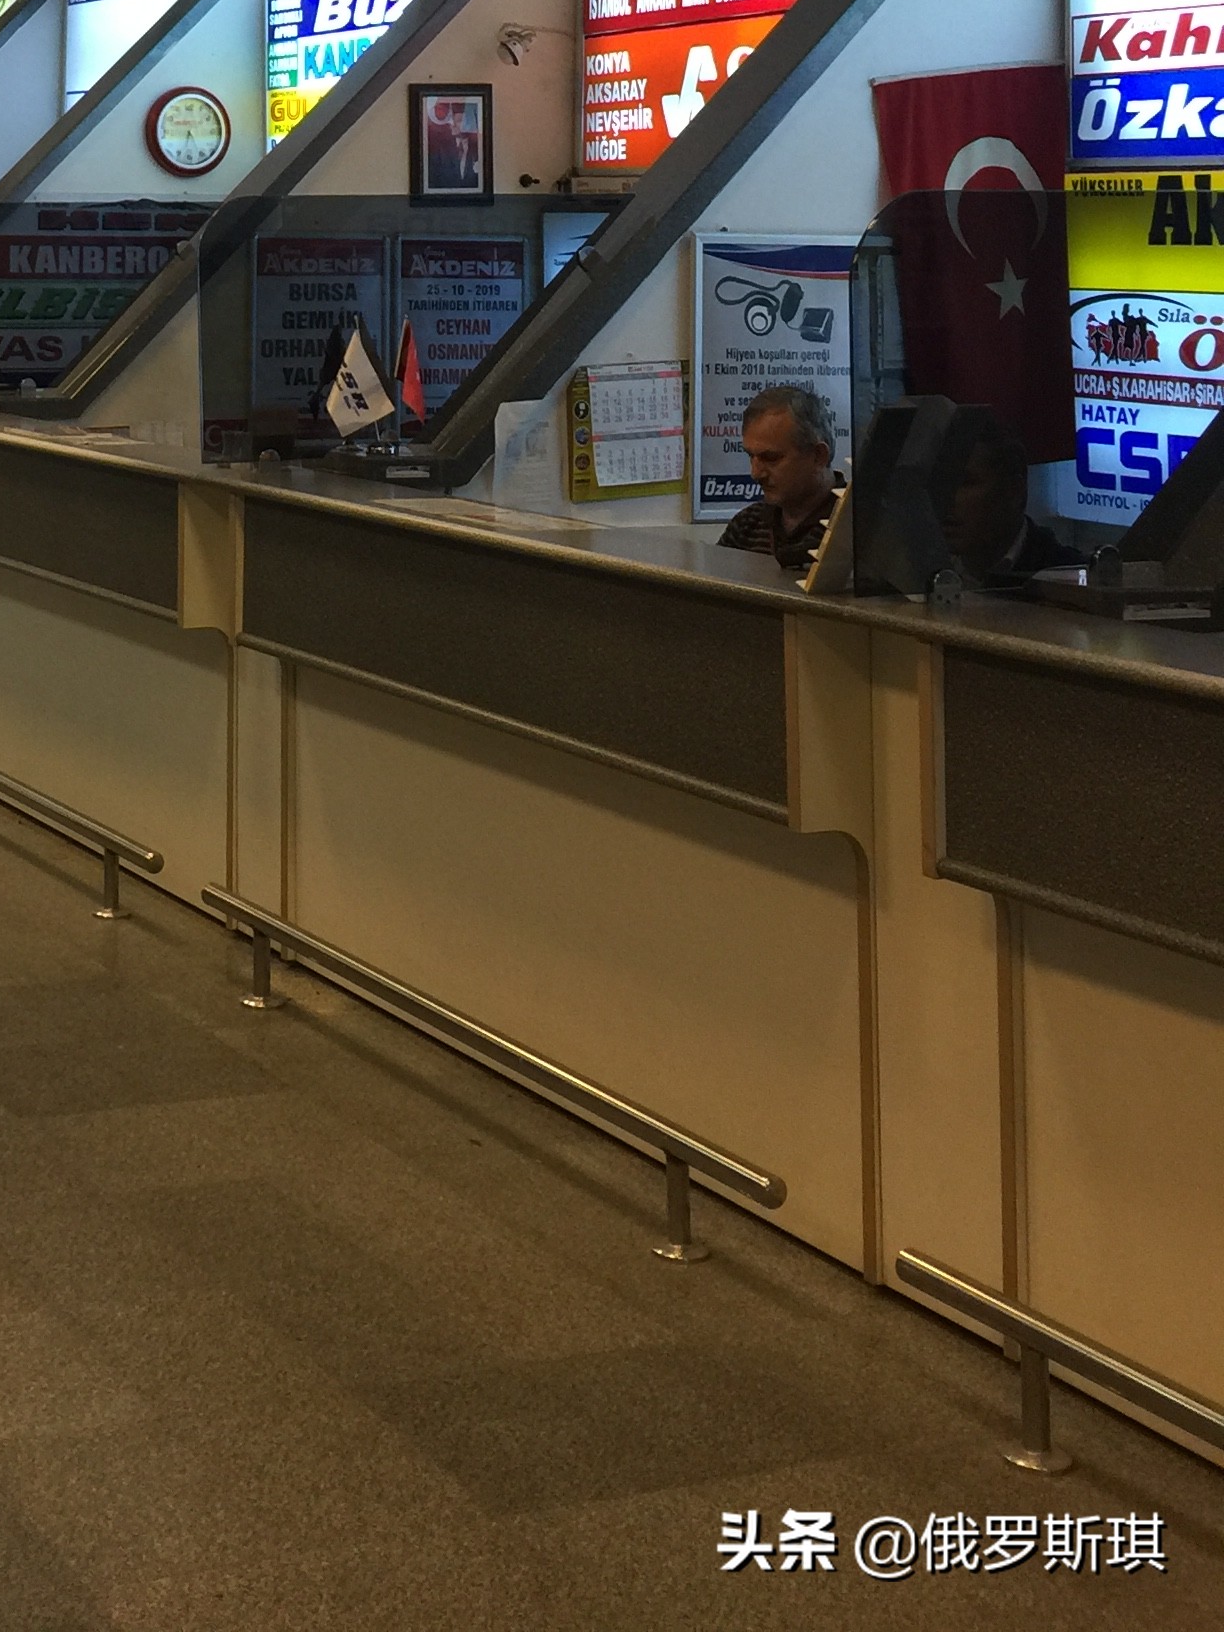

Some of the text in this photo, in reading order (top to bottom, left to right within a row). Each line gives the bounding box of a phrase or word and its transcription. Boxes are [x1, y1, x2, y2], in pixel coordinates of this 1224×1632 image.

[1079, 12, 1224, 64] Kah
[585, 50, 631, 76] KONYA
[585, 78, 648, 104] AKSARAY
[585, 104, 654, 136] NEVŞEHİR
[585, 135, 627, 163] NİĞDE
[1070, 177, 1145, 196] YÜKSELLER
[8, 244, 171, 275] KANBERO
[262, 245, 376, 274] AKDENİZ
[407, 246, 517, 277] AKDENİZ
[288, 282, 358, 301] BURSA
[426, 284, 501, 296] 25 10 2019
[408, 298, 518, 311] TARİHİNDEN İTİBAREN
[1157, 306, 1192, 325] Sıla
[436, 319, 491, 335] CEYHAN
[726, 348, 756, 361] Hijyen
[759, 348, 798, 362] koşulları
[419, 368, 473, 385] HRAMA
[714, 363, 738, 375] Ekim
[741, 363, 765, 375] 2018
[767, 363, 814, 376] tarihinden
[741, 381, 763, 392] araç
[1195, 382, 1224, 407] ŞİRA
[724, 397, 736, 406] ve
[1081, 403, 1141, 426] HATAY
[1077, 490, 1130, 510] DÖRTYOL
